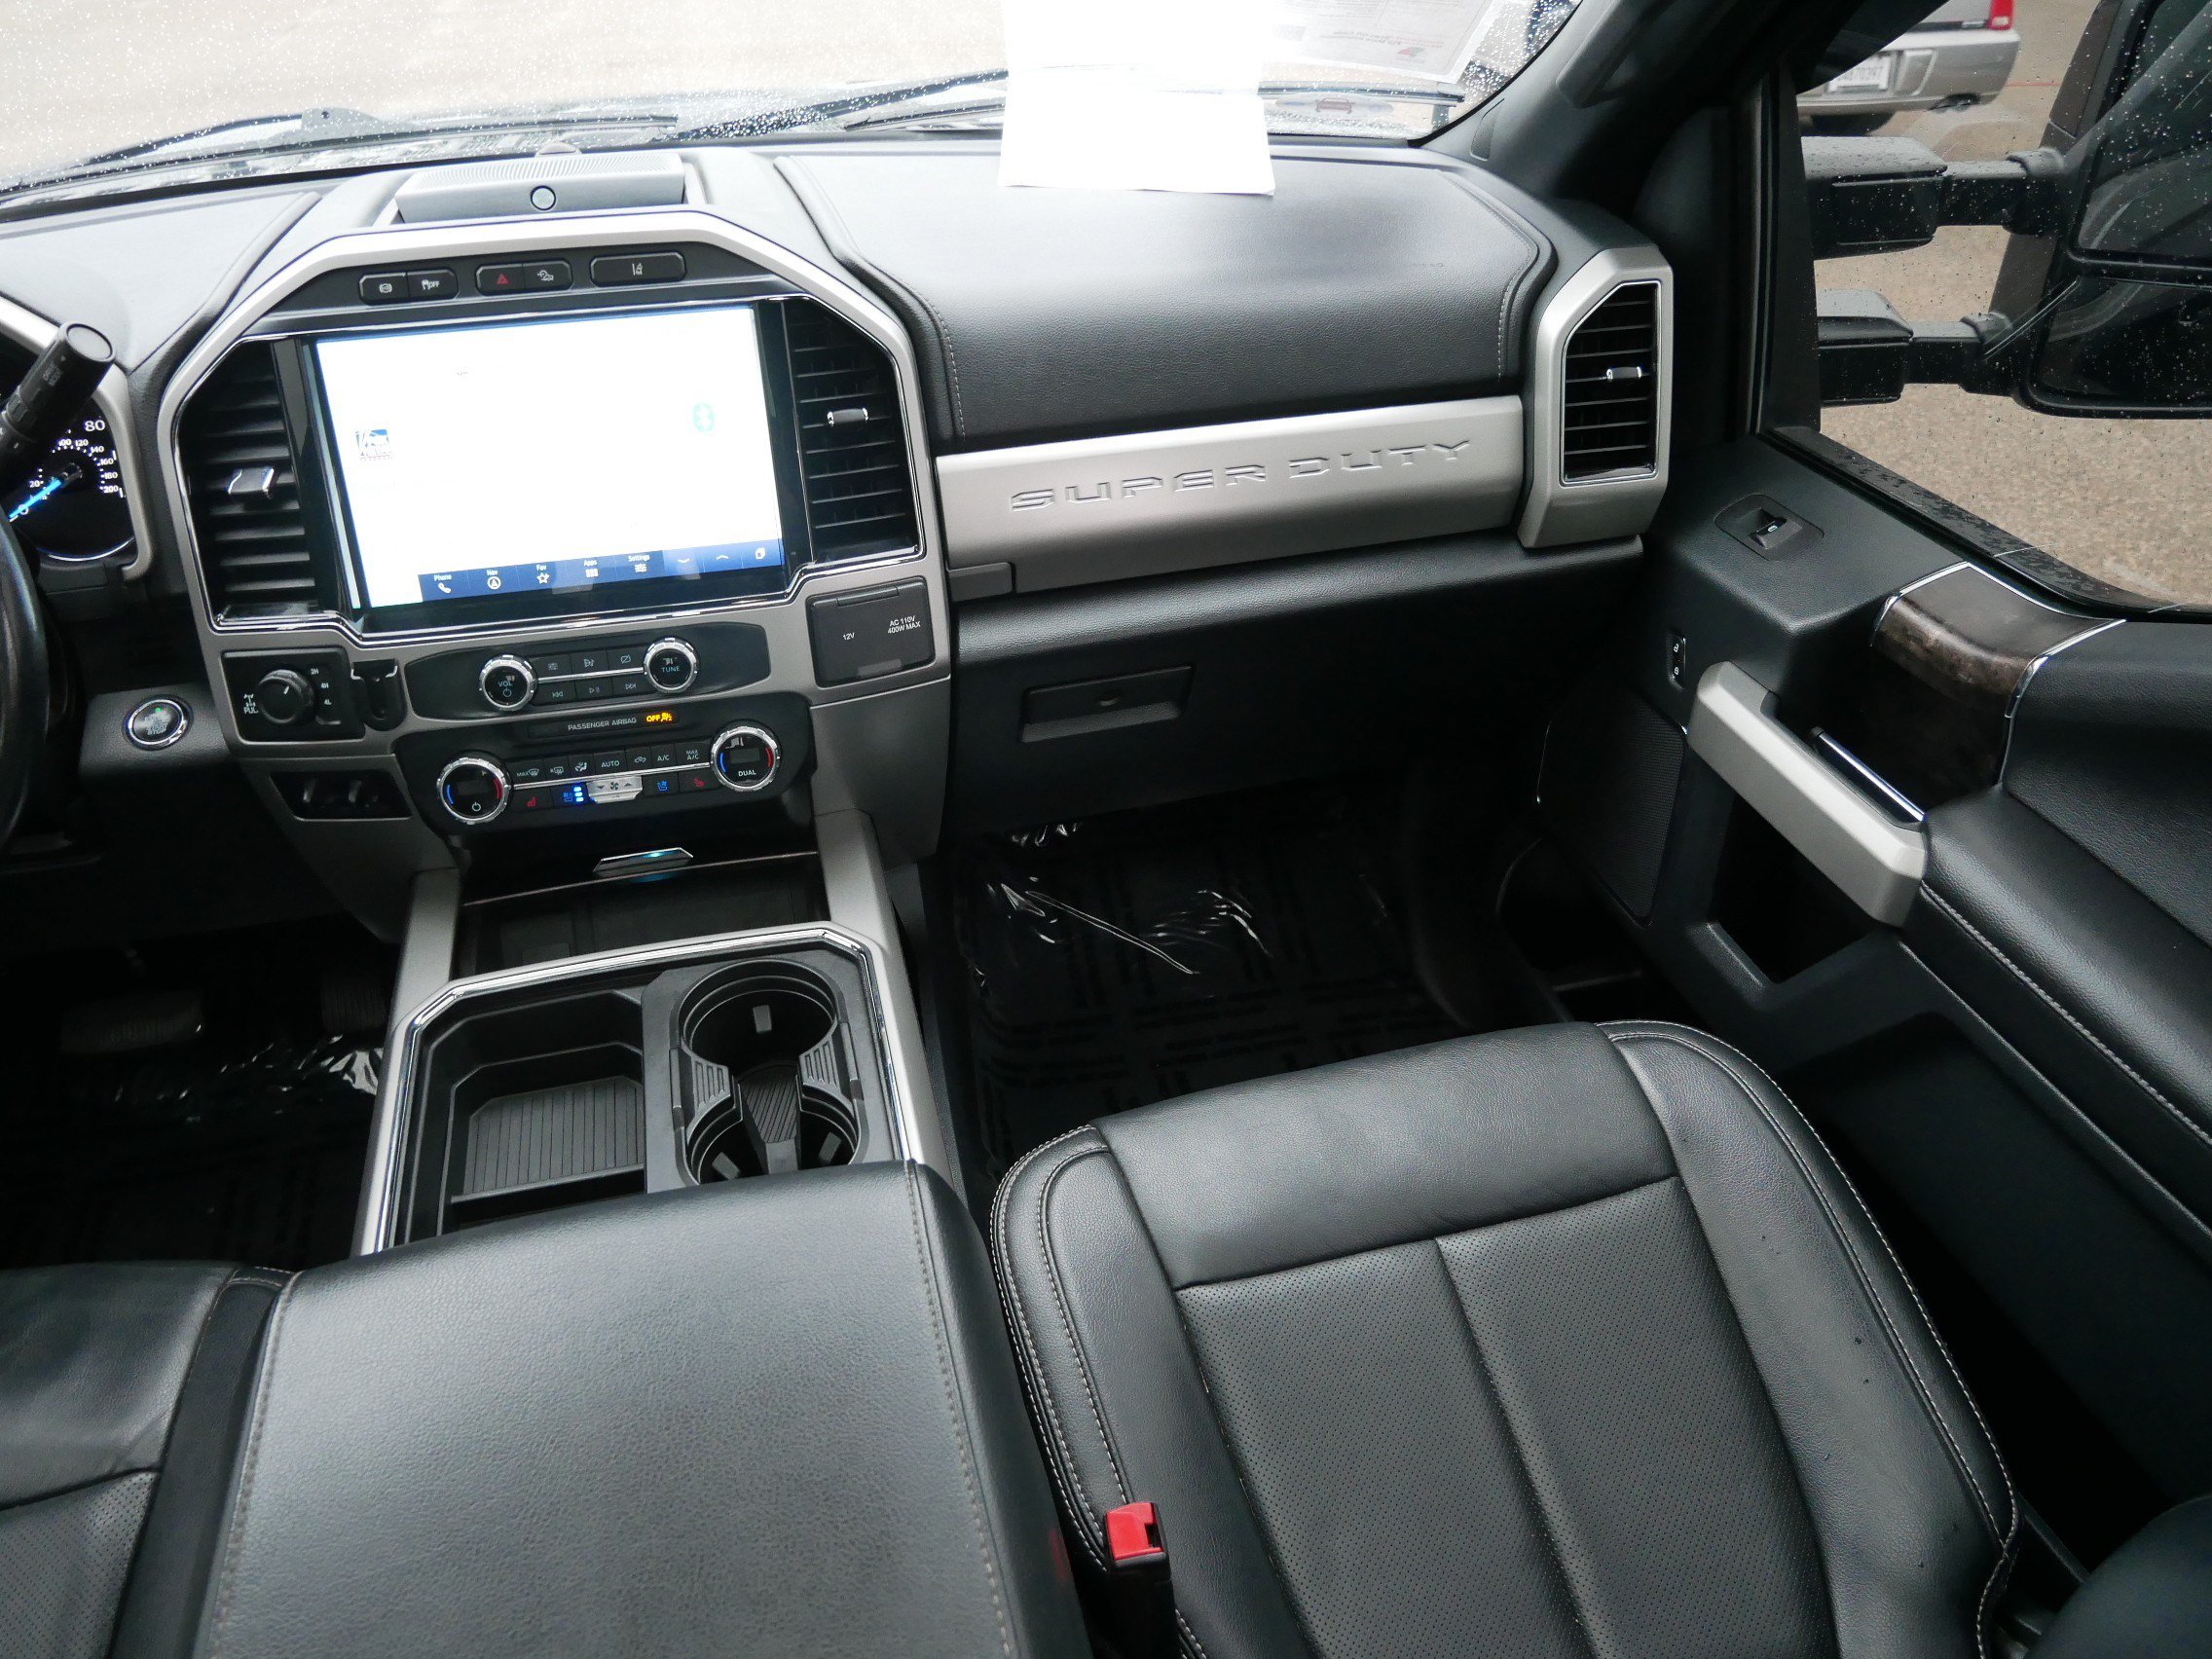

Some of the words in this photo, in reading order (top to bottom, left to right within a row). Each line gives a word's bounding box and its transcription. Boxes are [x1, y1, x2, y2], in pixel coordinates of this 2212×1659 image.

[85, 419, 106, 432] 80
[75, 438, 89, 447] 120
[91, 445, 104, 454] 140
[99, 457, 114, 465] 160
[1011, 463, 1267, 512] SUPER
[1289, 439, 1471, 479] DUTY
[103, 485, 119, 494] 200
[628, 554, 650, 563] Settings
[433, 573, 453, 582] Phone
[900, 615, 916, 624] 110V
[887, 625, 905, 634] 400W
[905, 621, 921, 630] MAX
[842, 632, 855, 641] 12V
[568, 719, 609, 731] PASSENGER
[611, 717, 638, 726] AIRBAG
[657, 754, 670, 762] A/C
[601, 759, 620, 768] AUTO
